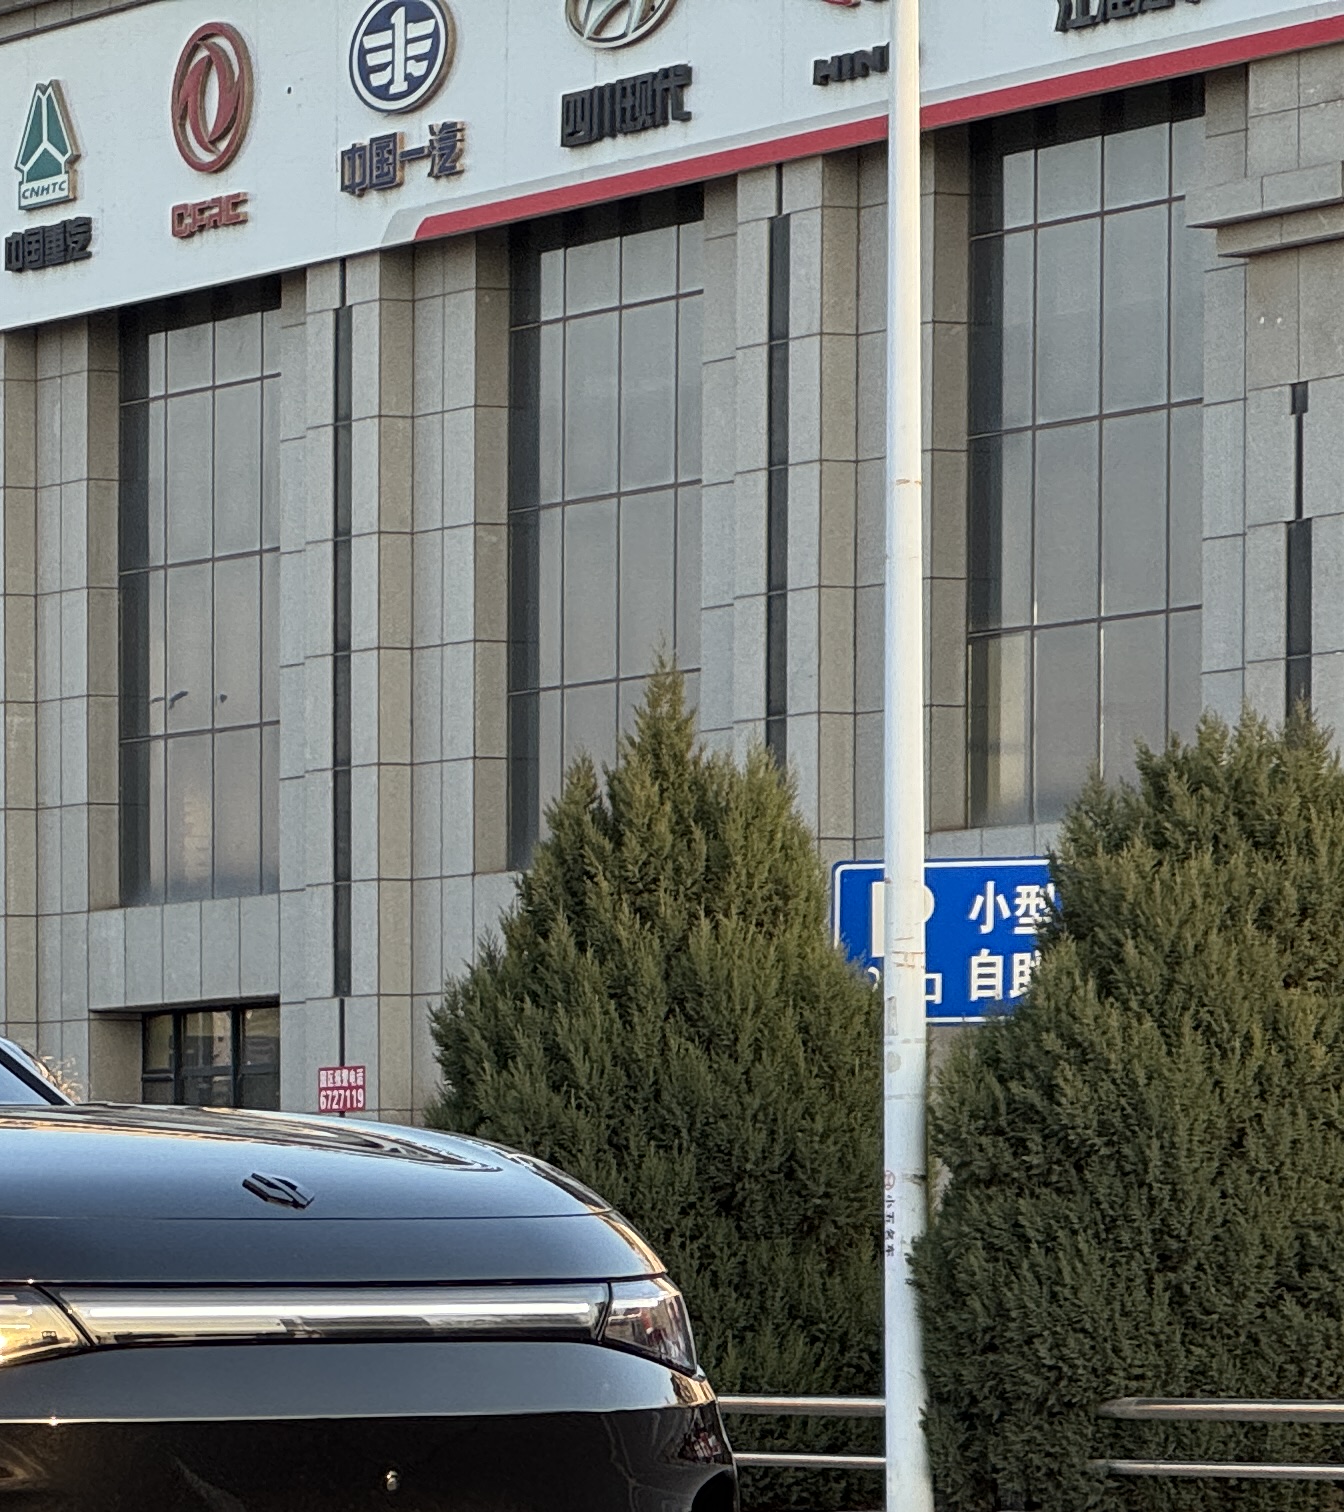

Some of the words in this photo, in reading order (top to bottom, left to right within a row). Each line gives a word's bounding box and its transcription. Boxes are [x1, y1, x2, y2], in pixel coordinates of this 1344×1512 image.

[813, 41, 890, 86] HIN
[560, 63, 693, 148] 四川现代
[340, 121, 466, 196] 中国一汽
[21, 180, 67, 200] CNHTC
[4, 216, 92, 272] 中国重汽
[319, 1088, 364, 1110] 6727119
